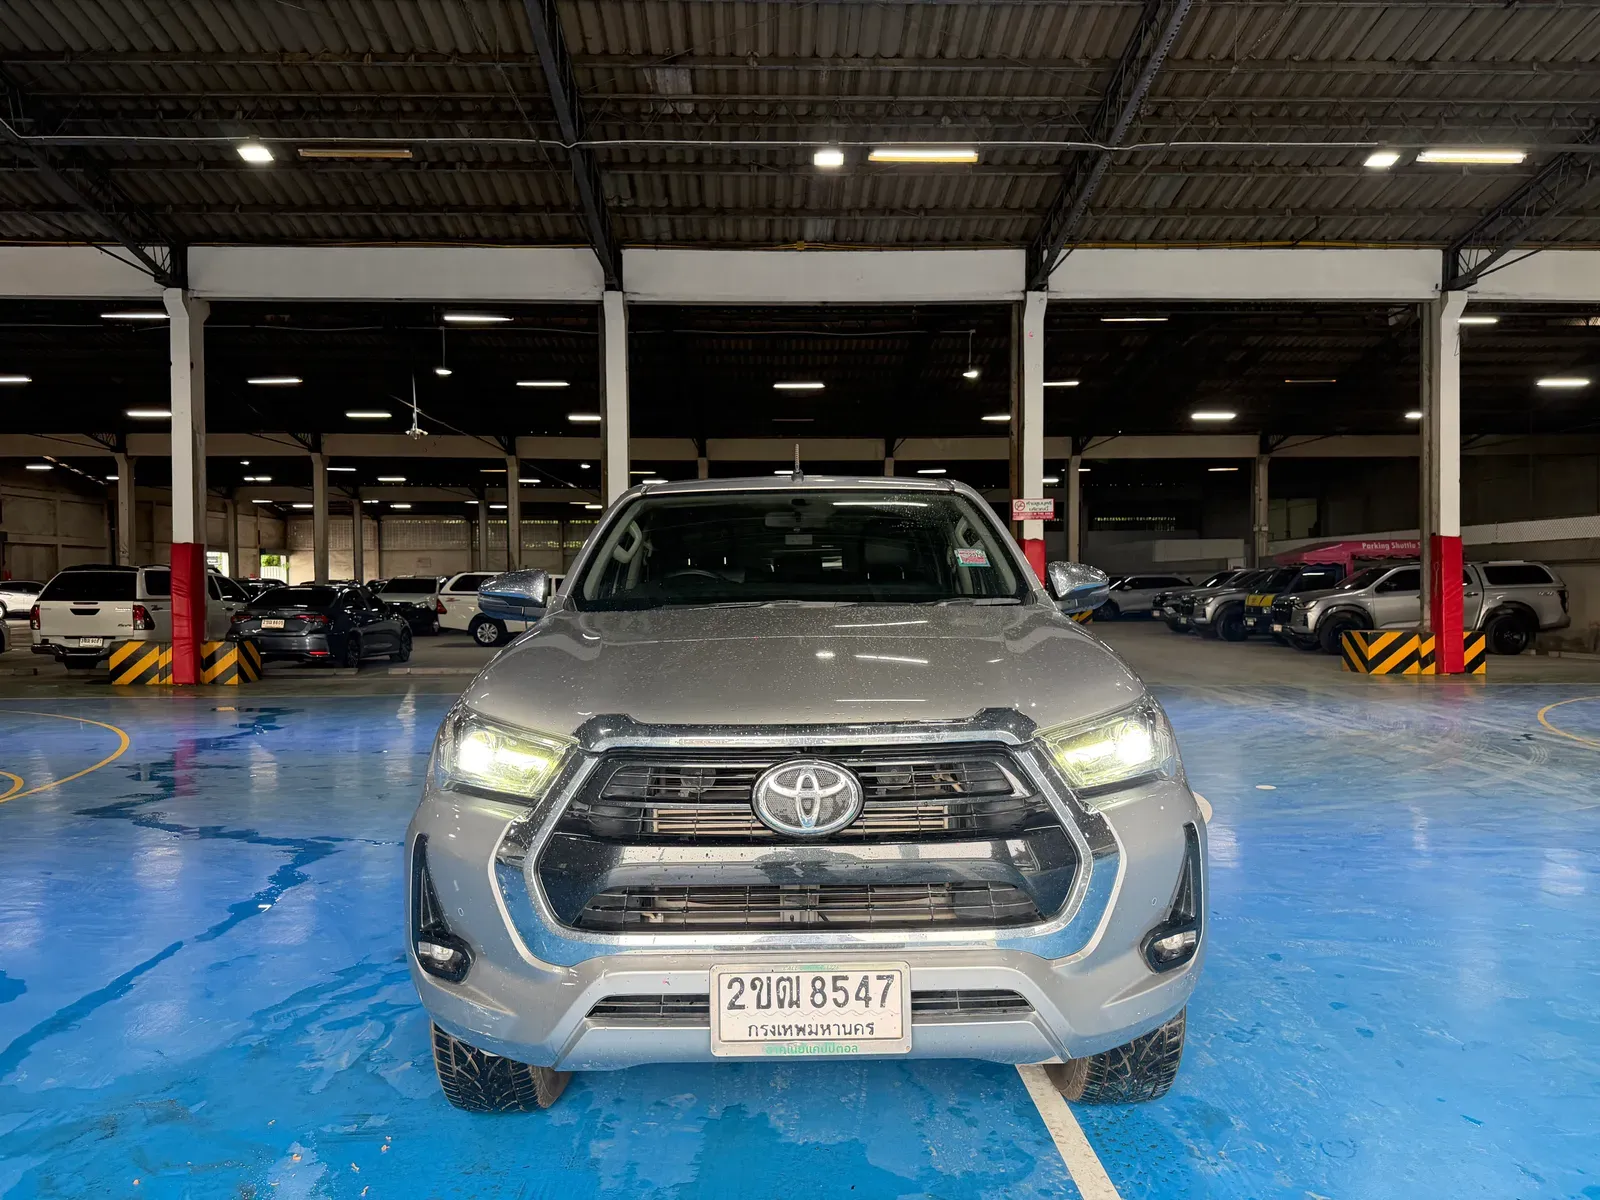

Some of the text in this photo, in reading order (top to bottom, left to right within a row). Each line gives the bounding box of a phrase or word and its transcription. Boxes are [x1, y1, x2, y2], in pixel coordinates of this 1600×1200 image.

[1362, 542, 1390, 550] Parking
[727, 975, 895, 1010] 2ขฒ 8547
[748, 1022, 875, 1037] กรงเทพมหานคร
